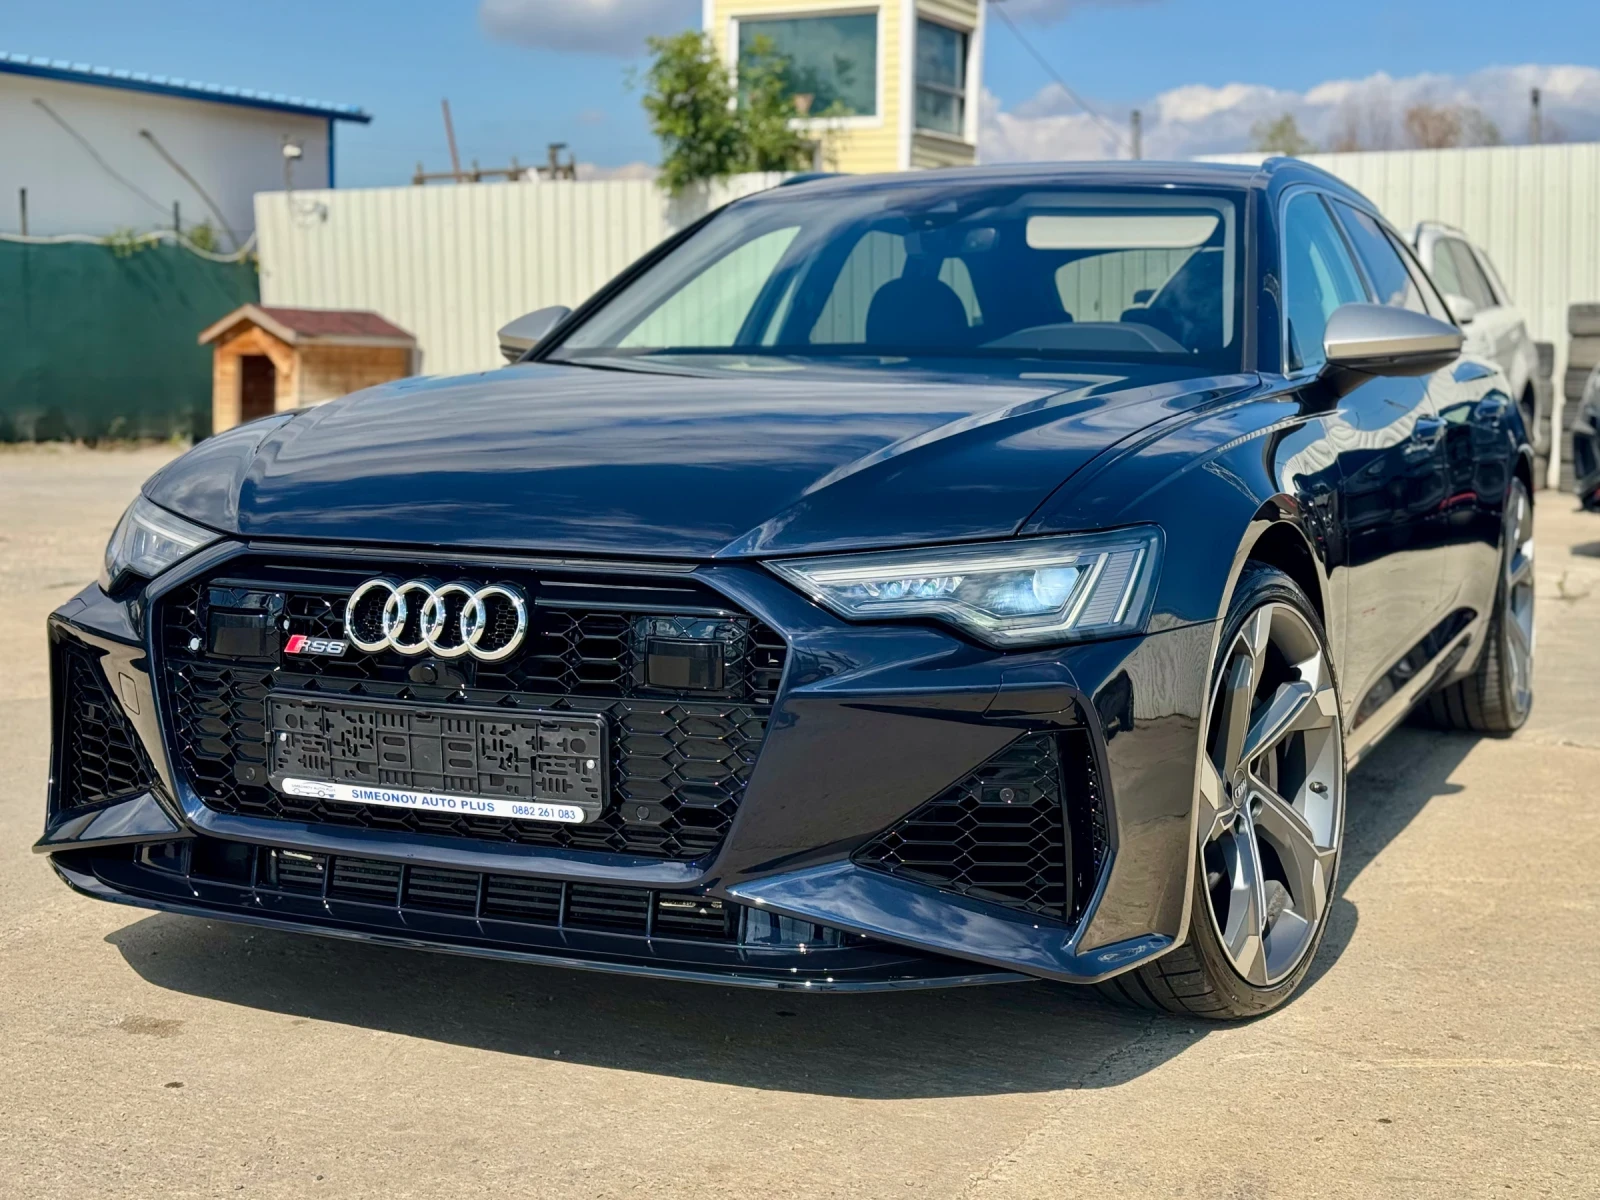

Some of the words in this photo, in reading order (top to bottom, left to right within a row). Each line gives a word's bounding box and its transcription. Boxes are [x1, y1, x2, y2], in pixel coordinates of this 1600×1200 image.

[294, 639, 345, 654] RS6
[351, 789, 417, 805] SIMEONOV
[421, 796, 457, 809] AUTO
[461, 800, 495, 812] PLUS
[512, 805, 536, 816] 0882
[538, 807, 555, 818] 261
[558, 809, 576, 820] 083
